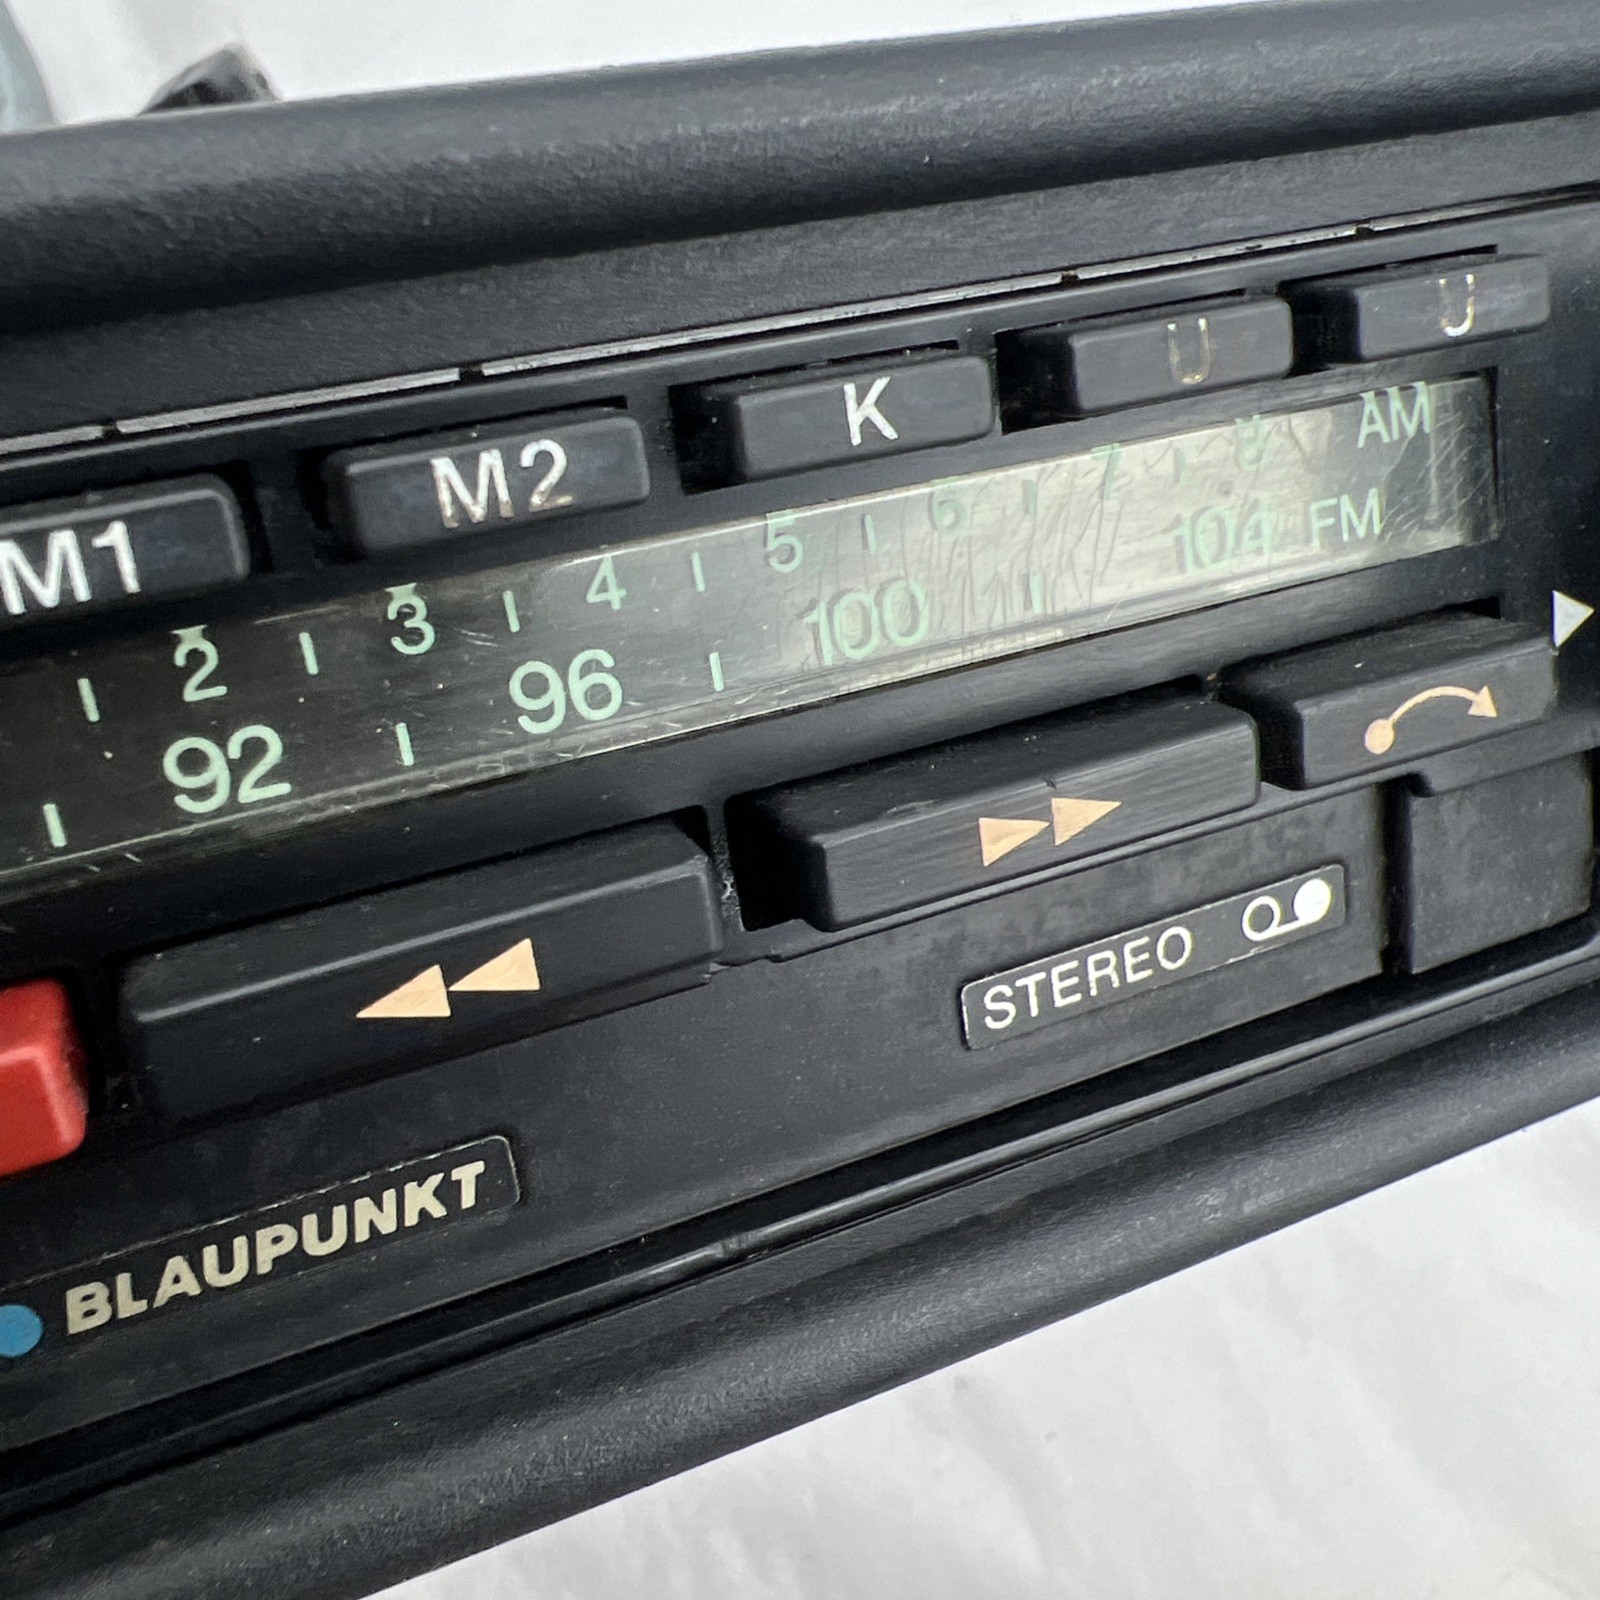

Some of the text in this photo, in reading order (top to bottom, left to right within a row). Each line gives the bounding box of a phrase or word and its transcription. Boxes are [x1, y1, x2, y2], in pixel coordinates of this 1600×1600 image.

[843, 376, 899, 446] K
[431, 438, 573, 529] M2
[0, 520, 141, 615] M1
[173, 637, 227, 702] 2
[387, 592, 436, 655] 3
[586, 552, 628, 611] 4
[764, 509, 804, 574] 5
[1357, 381, 1432, 449] AM
[163, 488, 1382, 813] 92 96 100 104 FM
[983, 926, 1193, 1030] STEREO
[65, 1160, 485, 1335] BLAUPUNKT
